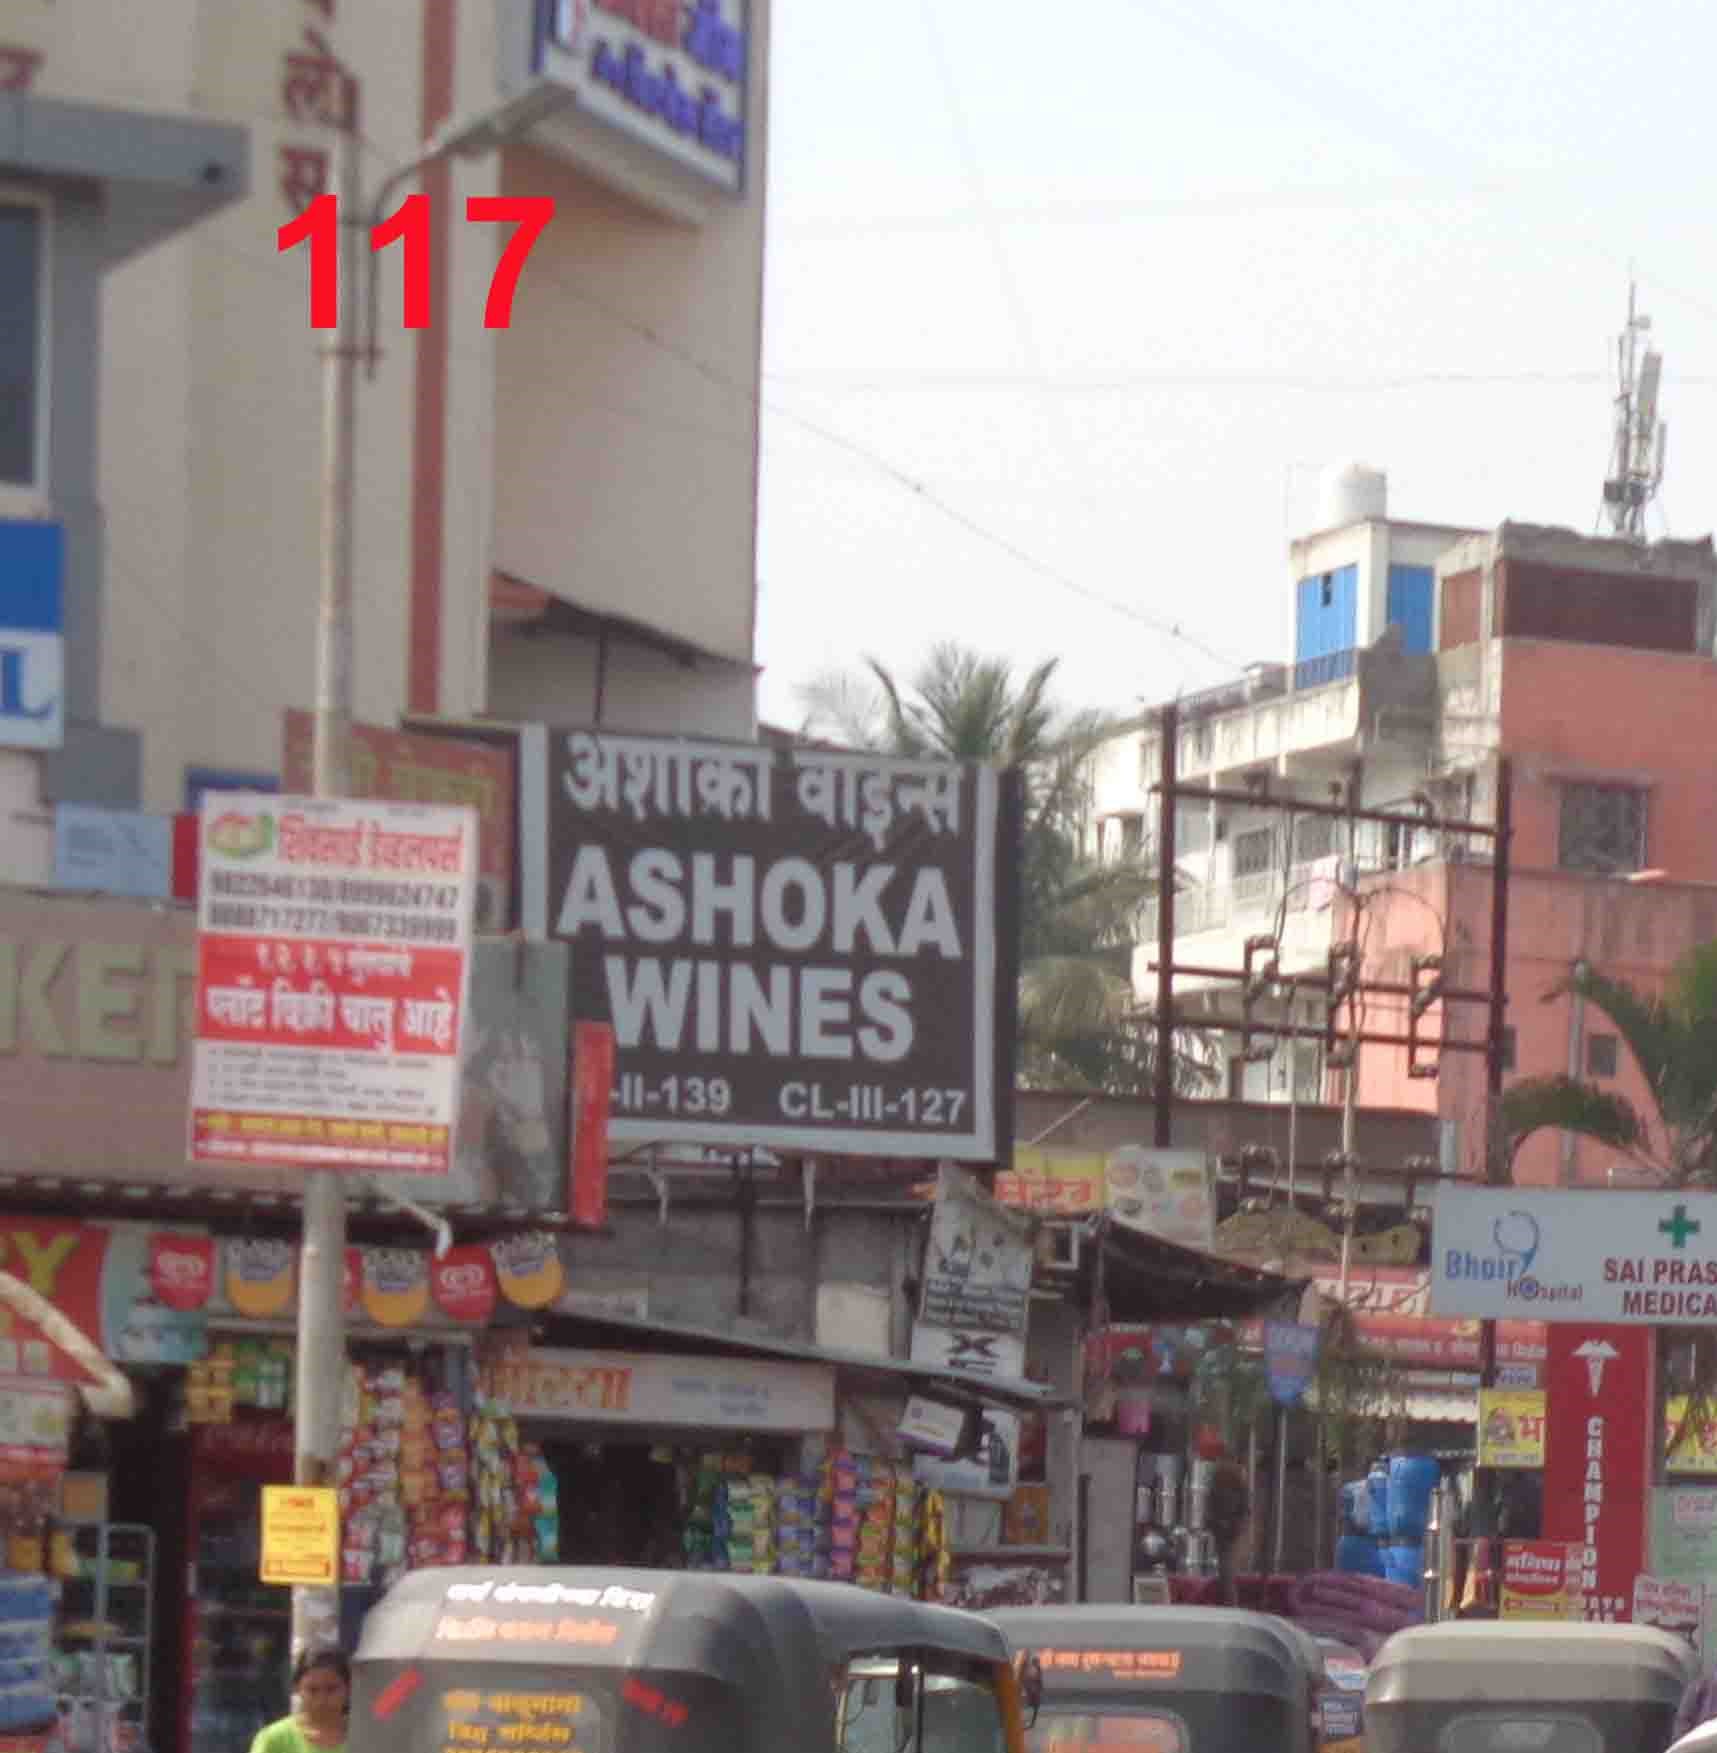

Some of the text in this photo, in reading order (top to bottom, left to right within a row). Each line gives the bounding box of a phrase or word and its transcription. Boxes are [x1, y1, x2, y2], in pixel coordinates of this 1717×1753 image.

[556, 845, 962, 958] ASHOKA
[604, 957, 913, 1062] WINES
[778, 1082, 966, 1124] CL-III-127
[1603, 1257, 1644, 1284] SAI
[1582, 1416, 1604, 1589] CHAMPION
